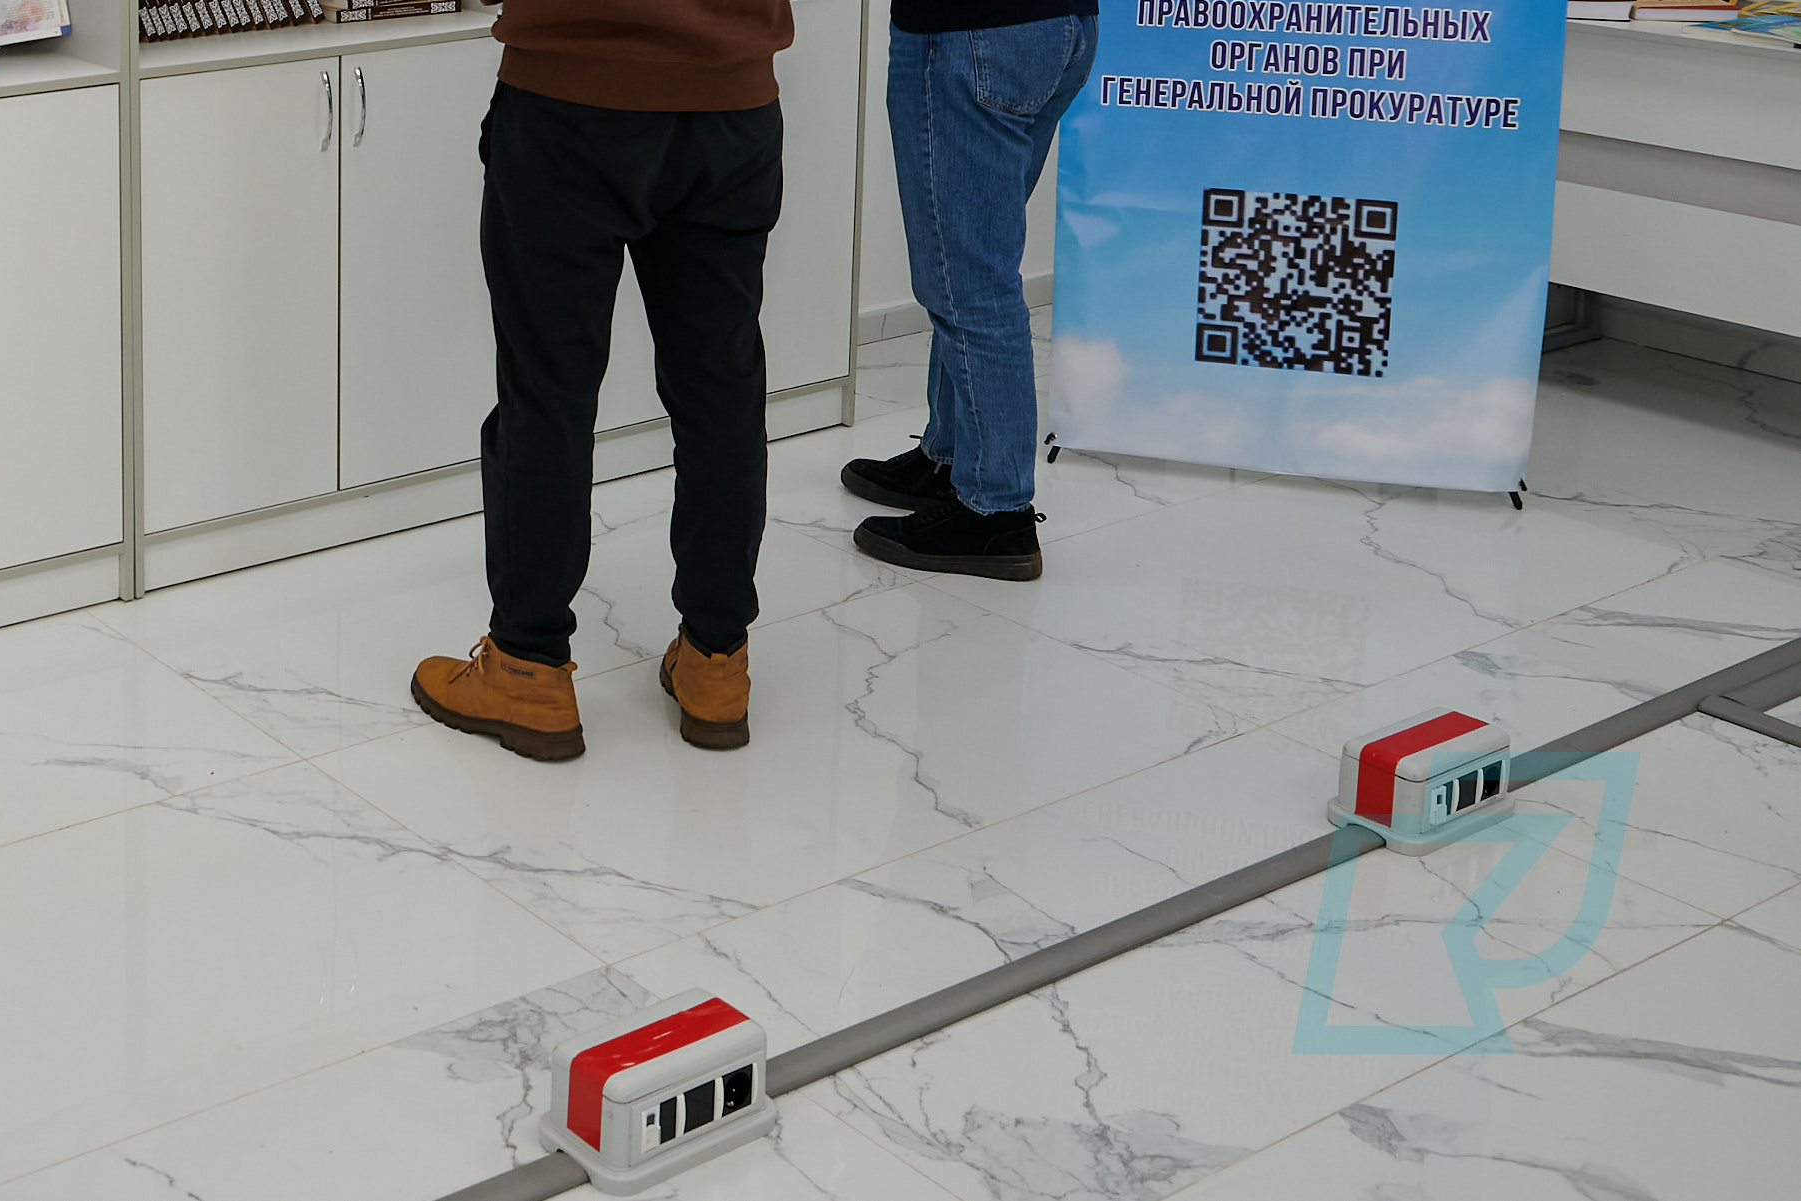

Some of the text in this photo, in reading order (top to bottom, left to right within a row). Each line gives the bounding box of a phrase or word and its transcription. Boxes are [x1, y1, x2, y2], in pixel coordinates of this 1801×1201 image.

[1210, 40, 1406, 80] ОРГАНОВ ПРИ
[1100, 76, 1520, 129] ГЕНЕРАЛЬНОЙ ПРОКУРАТУРЕ
